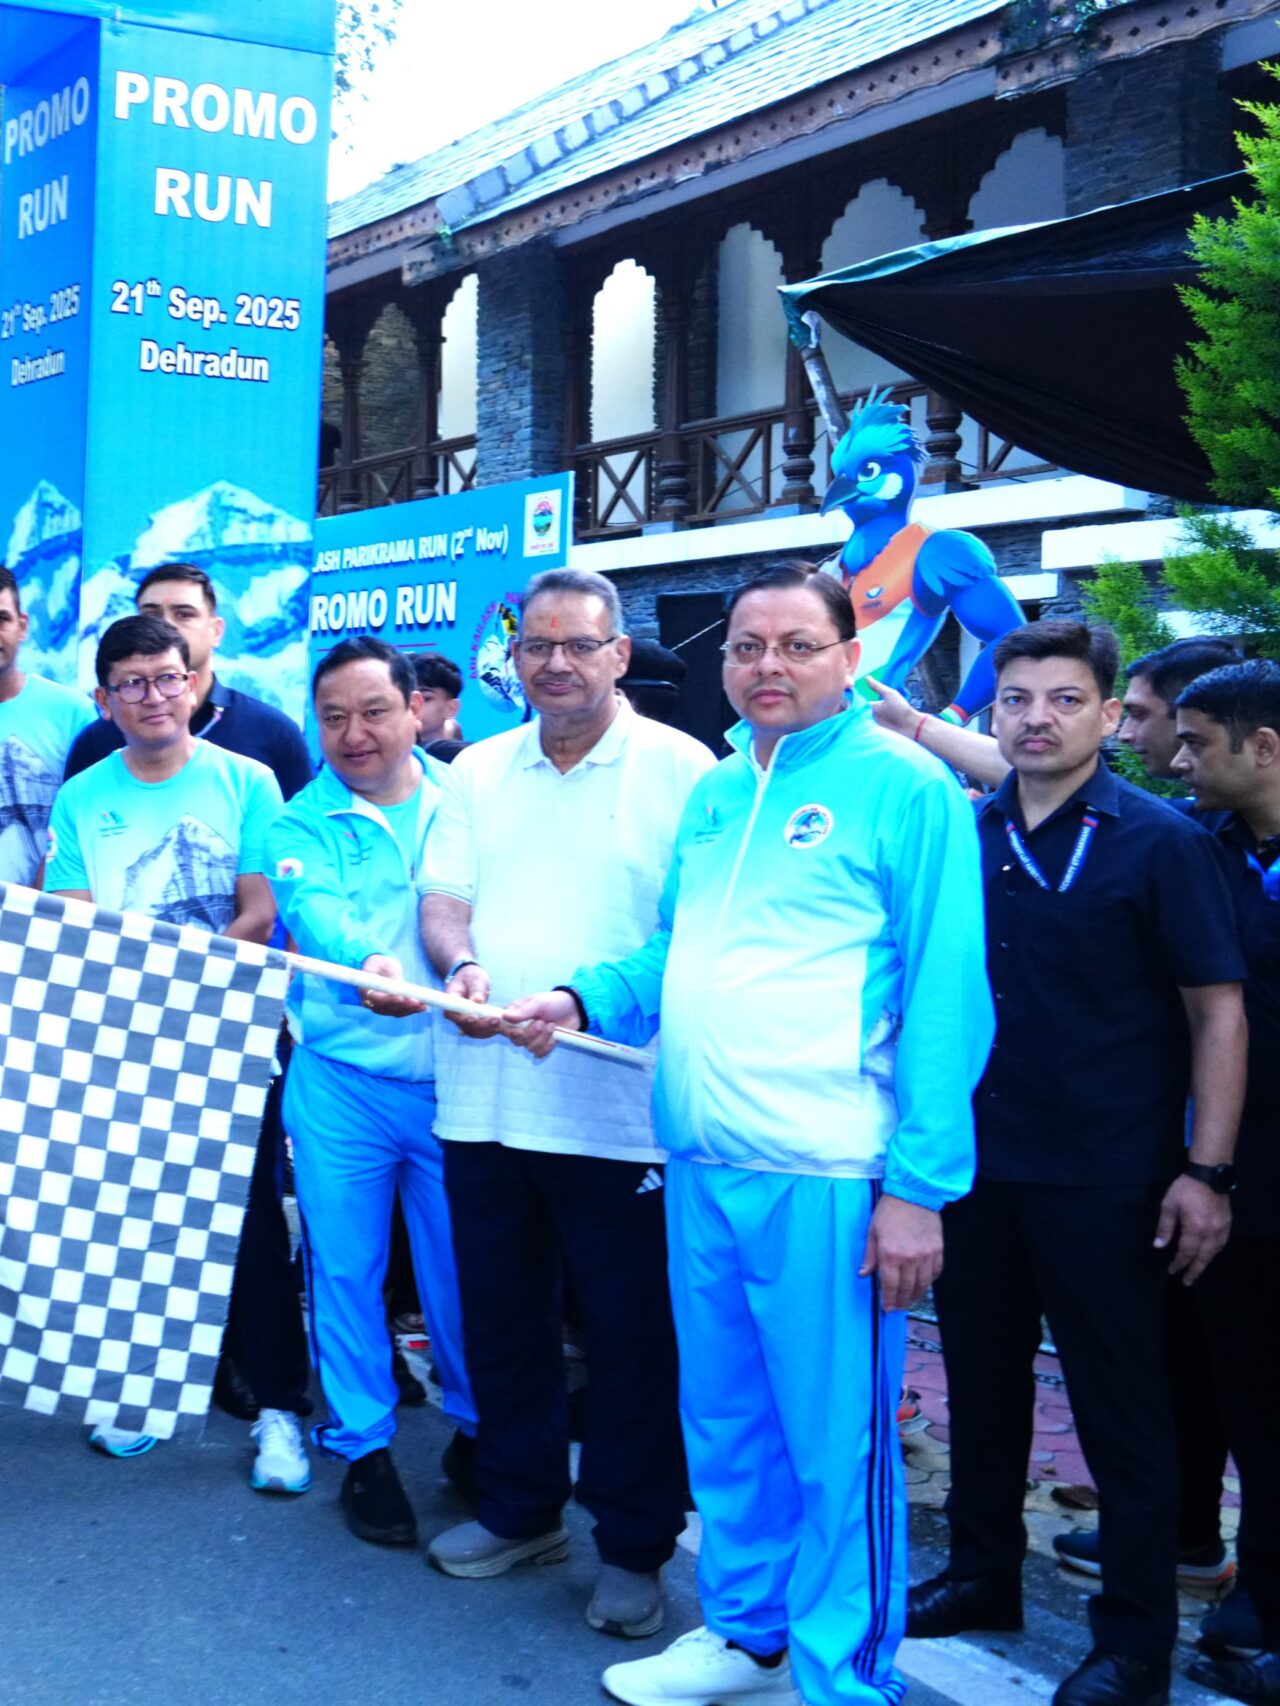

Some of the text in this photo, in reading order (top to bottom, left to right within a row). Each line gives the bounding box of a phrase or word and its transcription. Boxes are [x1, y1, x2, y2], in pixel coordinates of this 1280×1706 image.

[4, 76, 90, 165] PROMO
[114, 70, 318, 145] PROMO
[18, 174, 69, 240] RUN
[154, 166, 273, 228] RUN
[49, 284, 81, 322] 2025
[111, 279, 300, 330] 21th Sep. 2025
[10, 348, 66, 387] Dehradun
[140, 339, 270, 382] Dehradun
[342, 539, 416, 569] PARIKRAMA
[418, 533, 448, 560] RUN
[476, 523, 509, 555] Nov)
[395, 581, 457, 625] RUN
